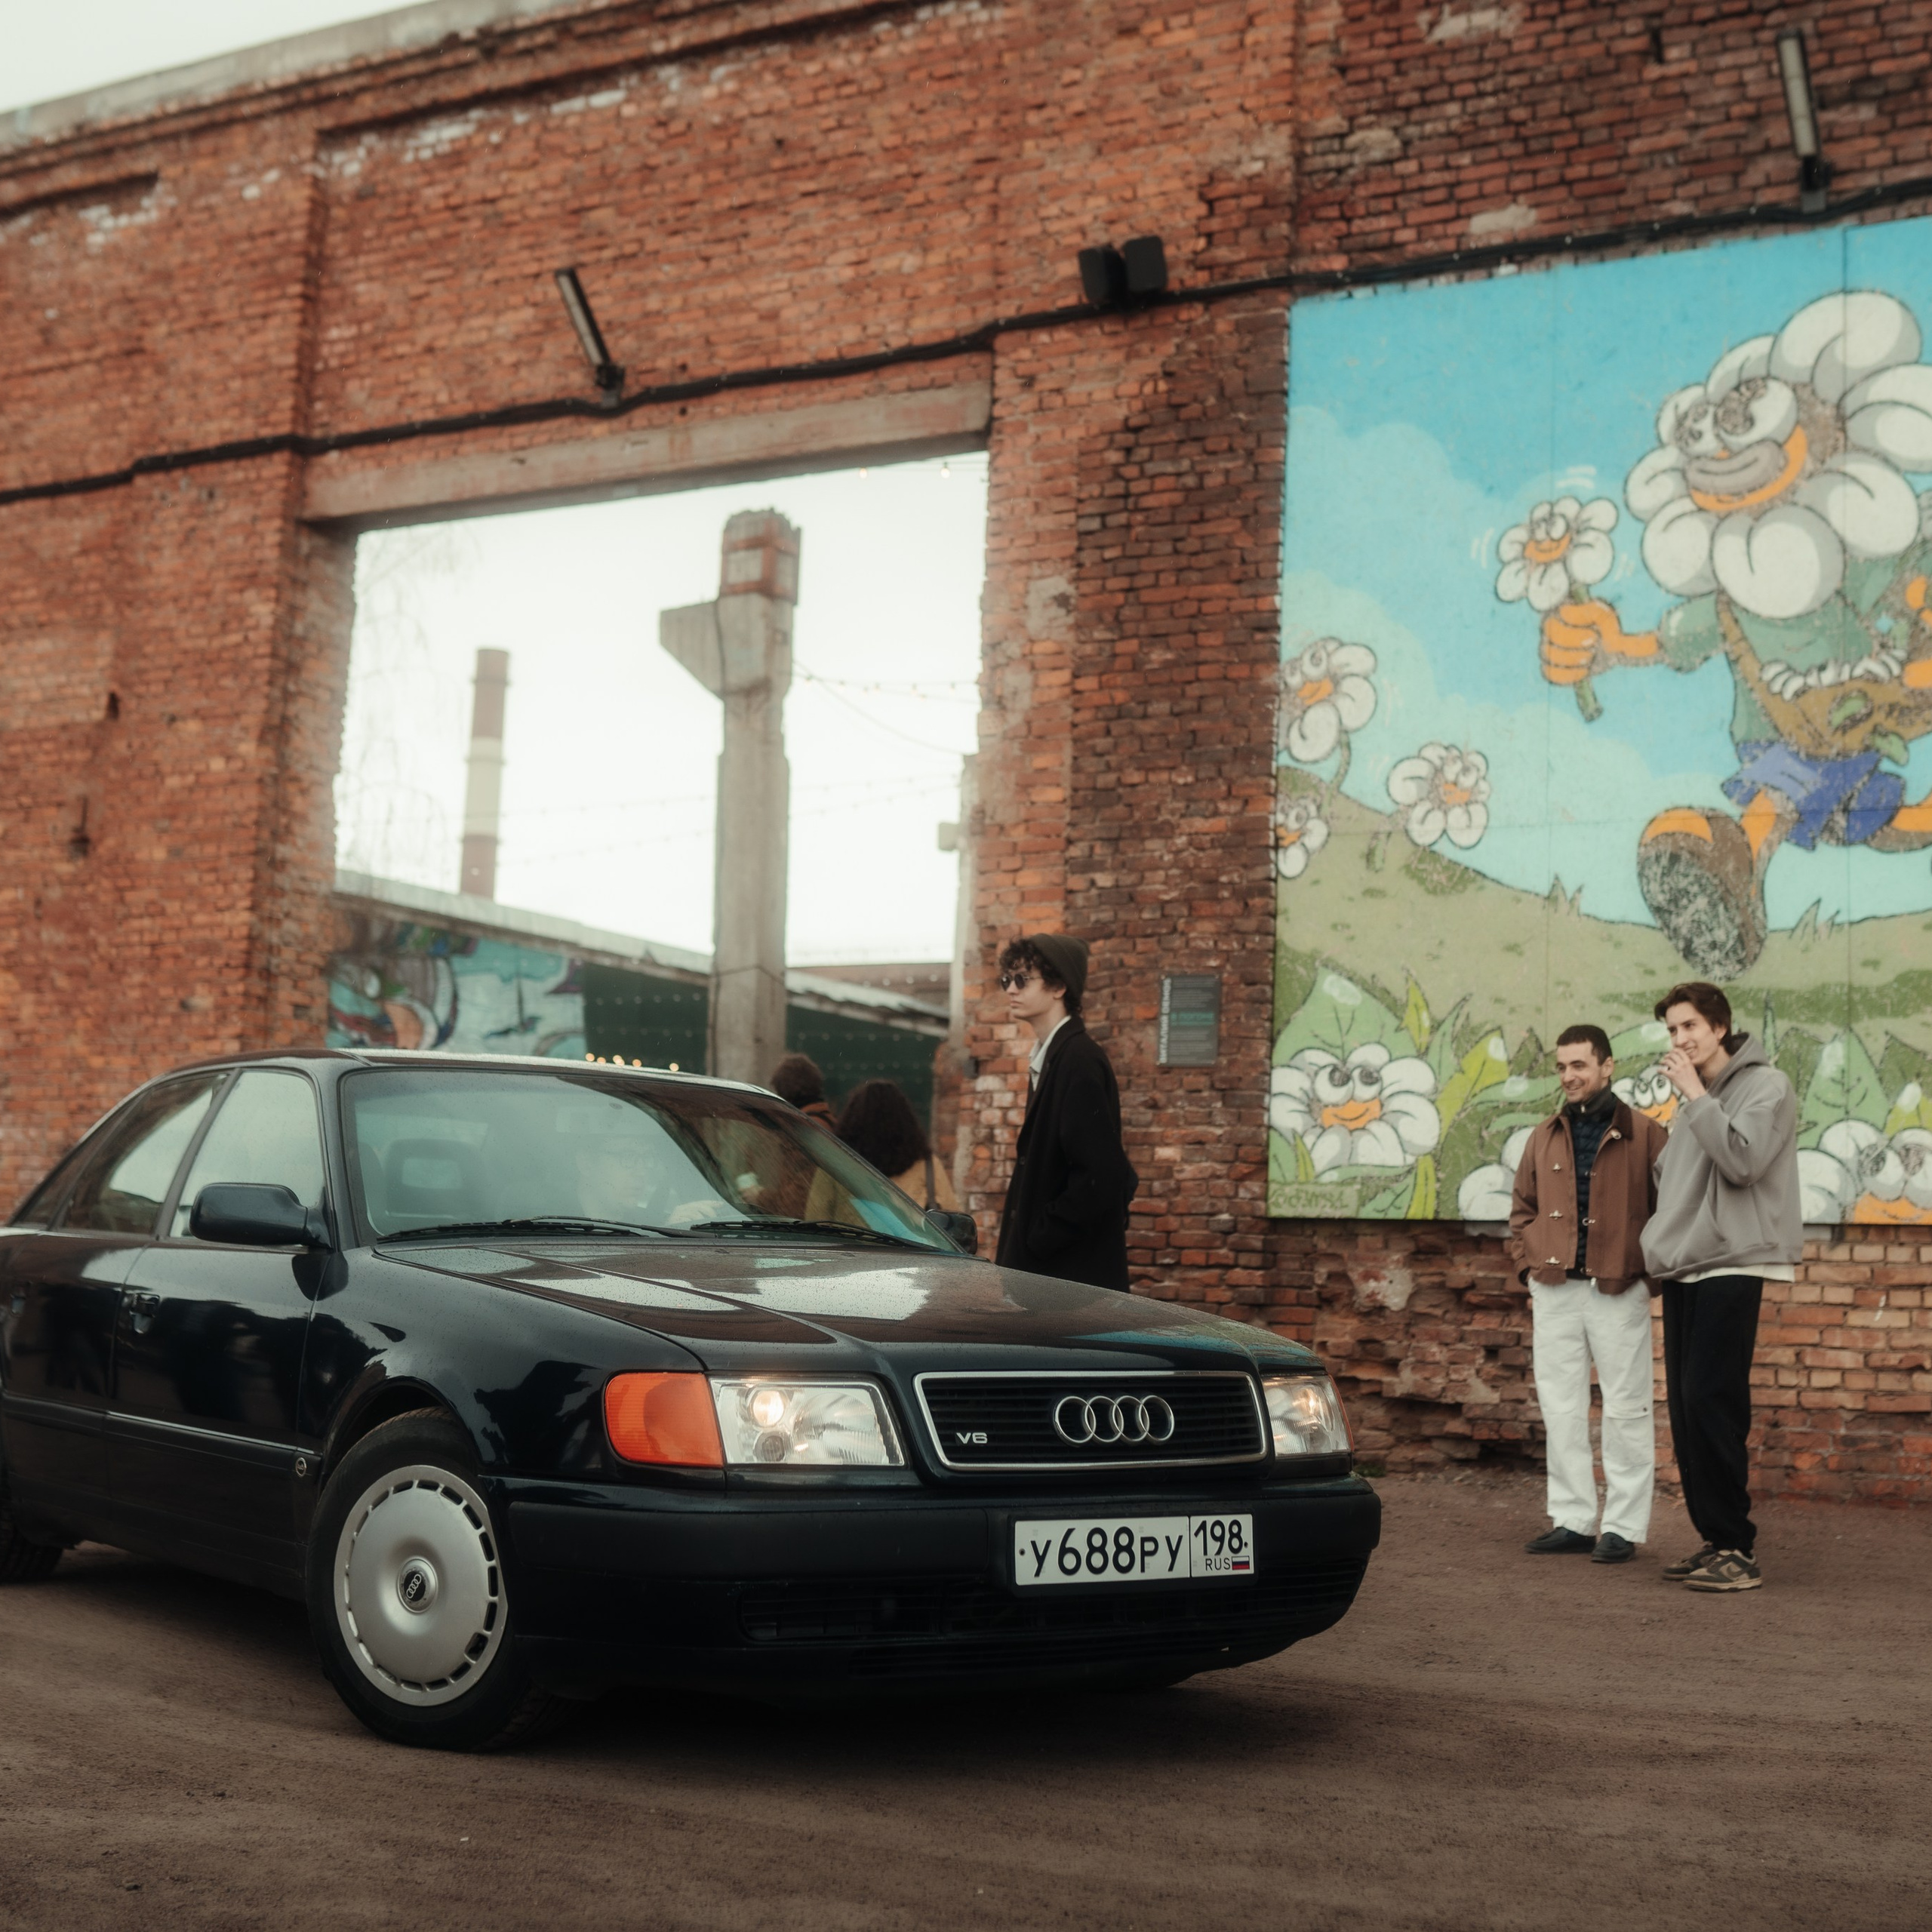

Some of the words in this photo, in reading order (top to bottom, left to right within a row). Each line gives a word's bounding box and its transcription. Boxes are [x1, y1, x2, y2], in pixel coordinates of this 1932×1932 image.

[955, 1432, 989, 1444] V6
[1194, 1518, 1244, 1556] 198
[1205, 1557, 1231, 1571] RUS
